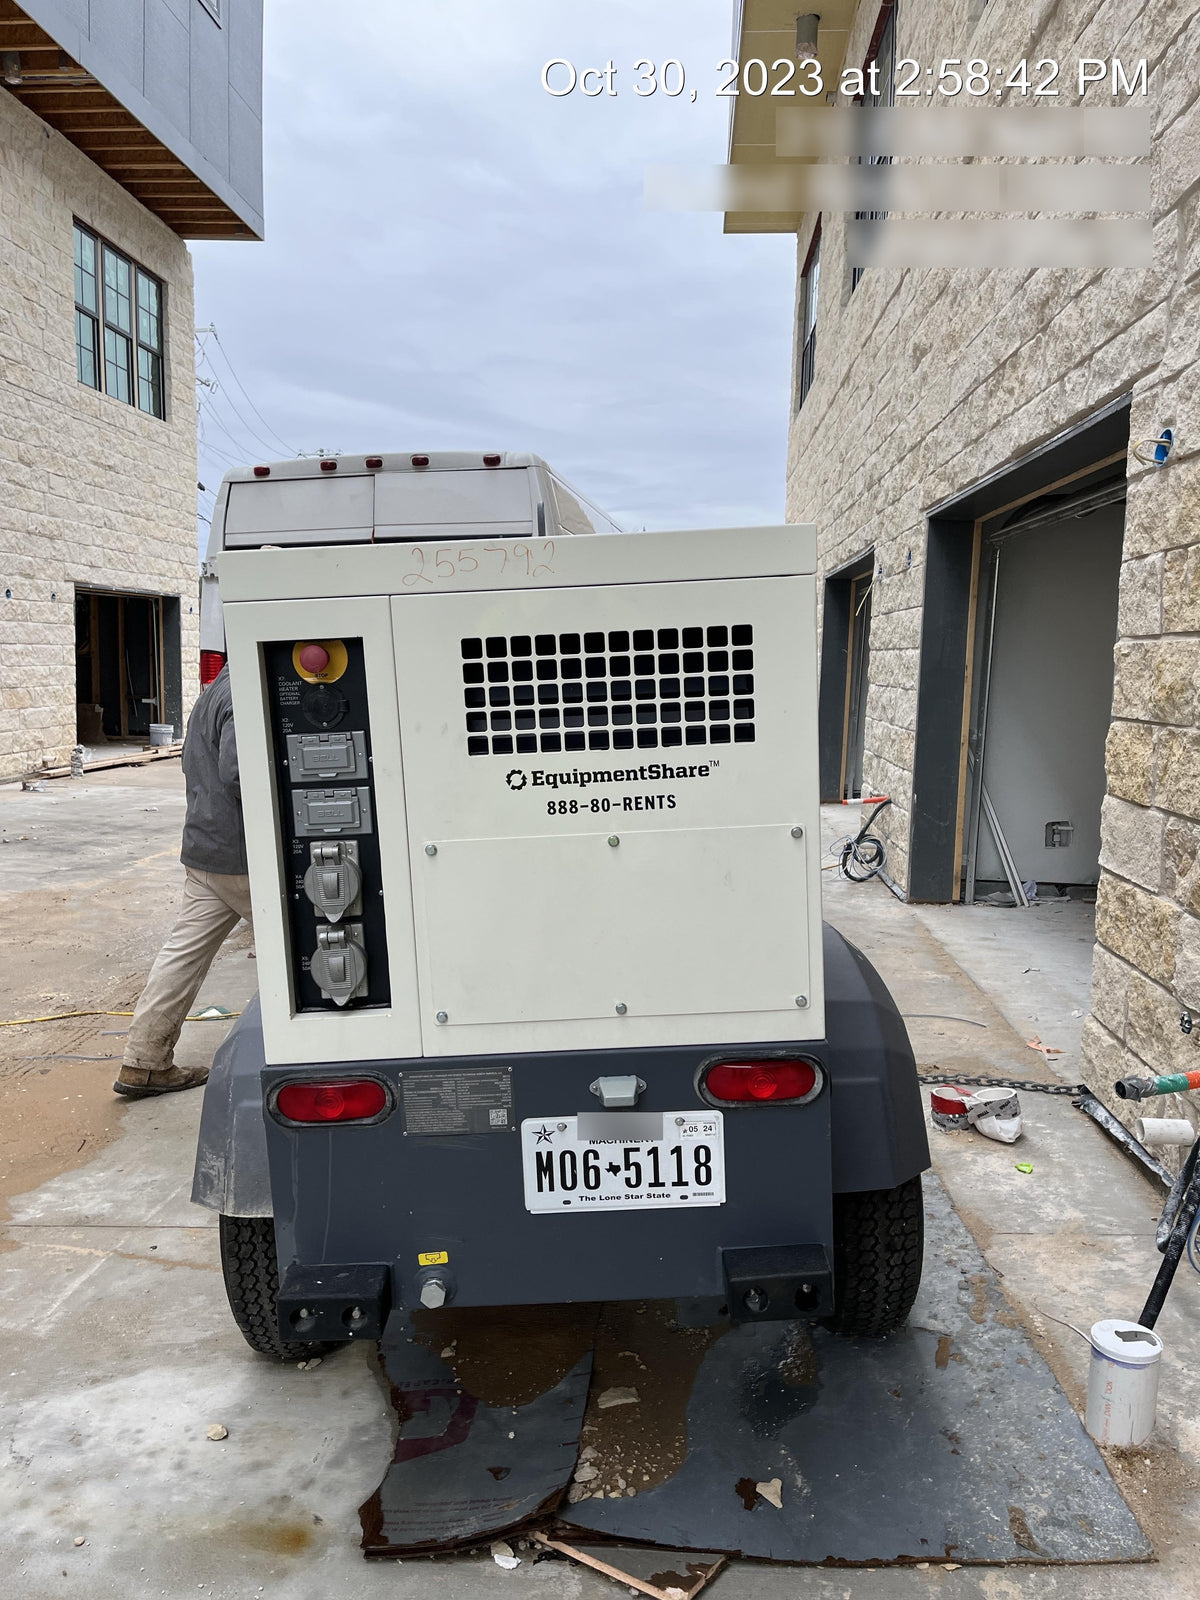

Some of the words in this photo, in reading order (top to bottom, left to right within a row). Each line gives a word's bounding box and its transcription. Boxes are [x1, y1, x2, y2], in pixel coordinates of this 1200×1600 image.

[402, 540, 555, 586] 255792
[547, 794, 677, 815] 888-80-RENTS
[688, 1125, 698, 1133] 05
[535, 1149, 601, 1192] M06
[623, 1144, 712, 1189] 5118
